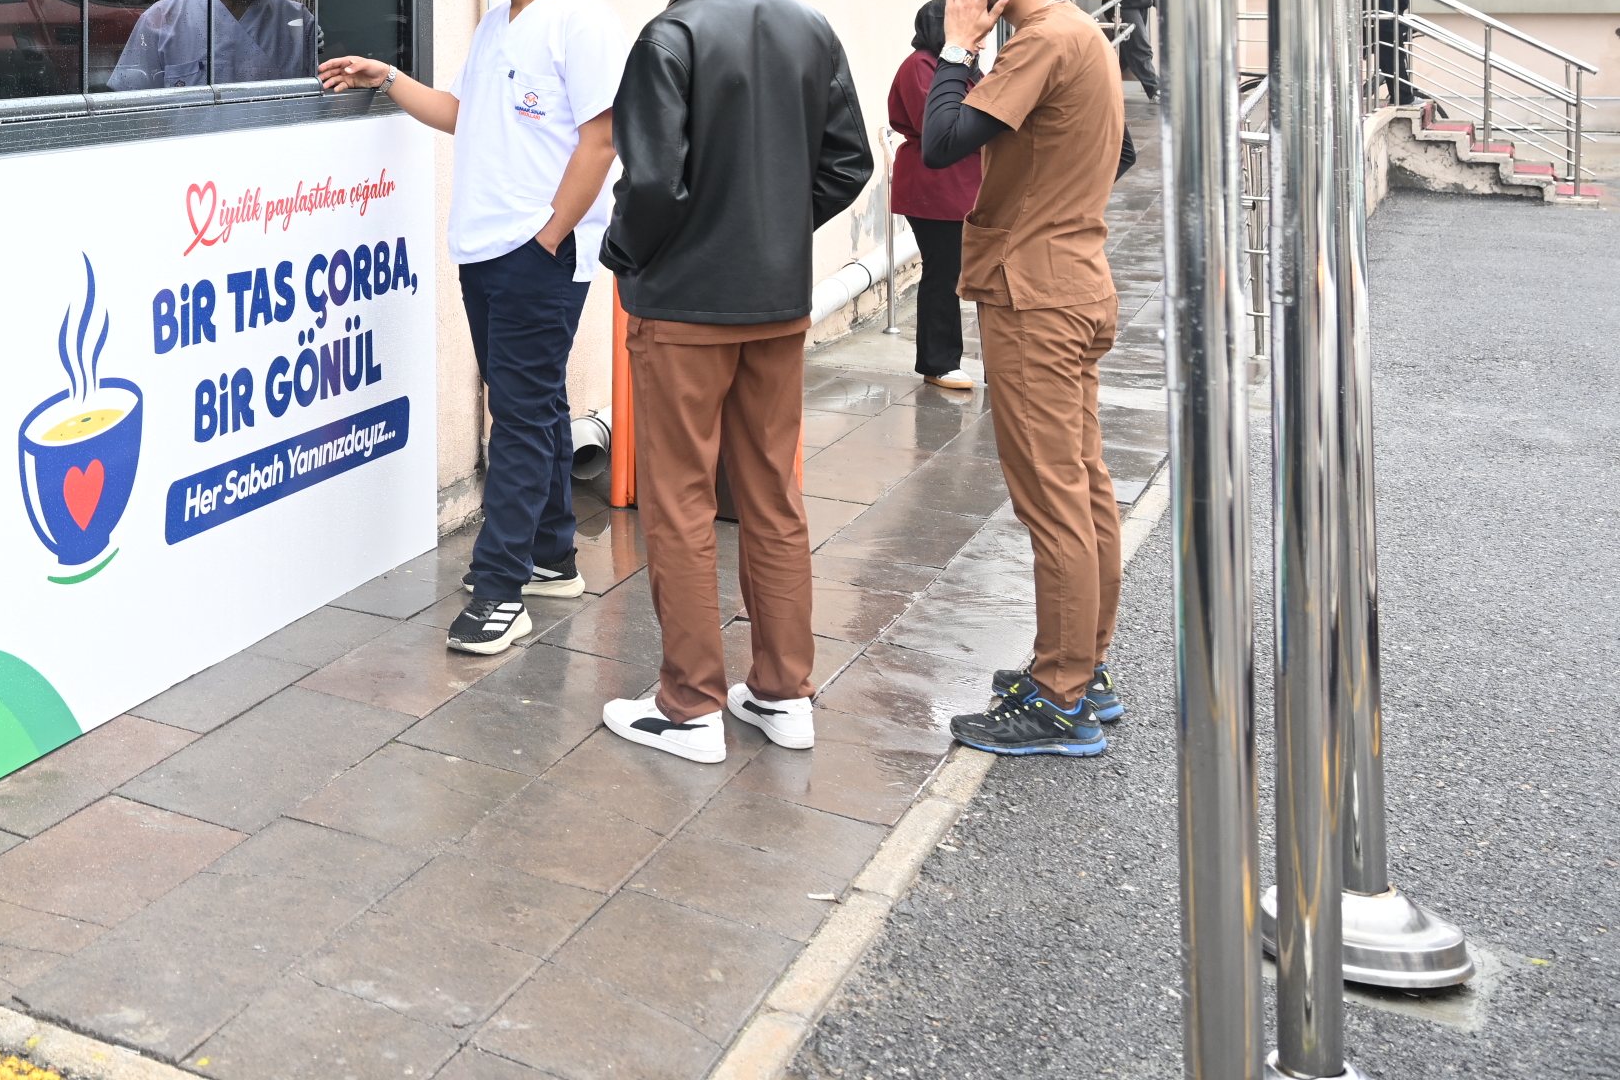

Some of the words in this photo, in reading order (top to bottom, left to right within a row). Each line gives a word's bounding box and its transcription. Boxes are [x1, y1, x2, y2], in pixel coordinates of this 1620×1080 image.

[219, 186, 262, 244] iyilik
[265, 176, 346, 234] paylaştıkça
[350, 168, 395, 216] çoğalır
[227, 261, 295, 333] TAS
[305, 237, 417, 329] ÇORBA,
[265, 315, 382, 418] GÖNÜL
[185, 484, 222, 521] Her
[224, 454, 283, 504] Sabah
[288, 421, 395, 478] Yanınızdayız...
